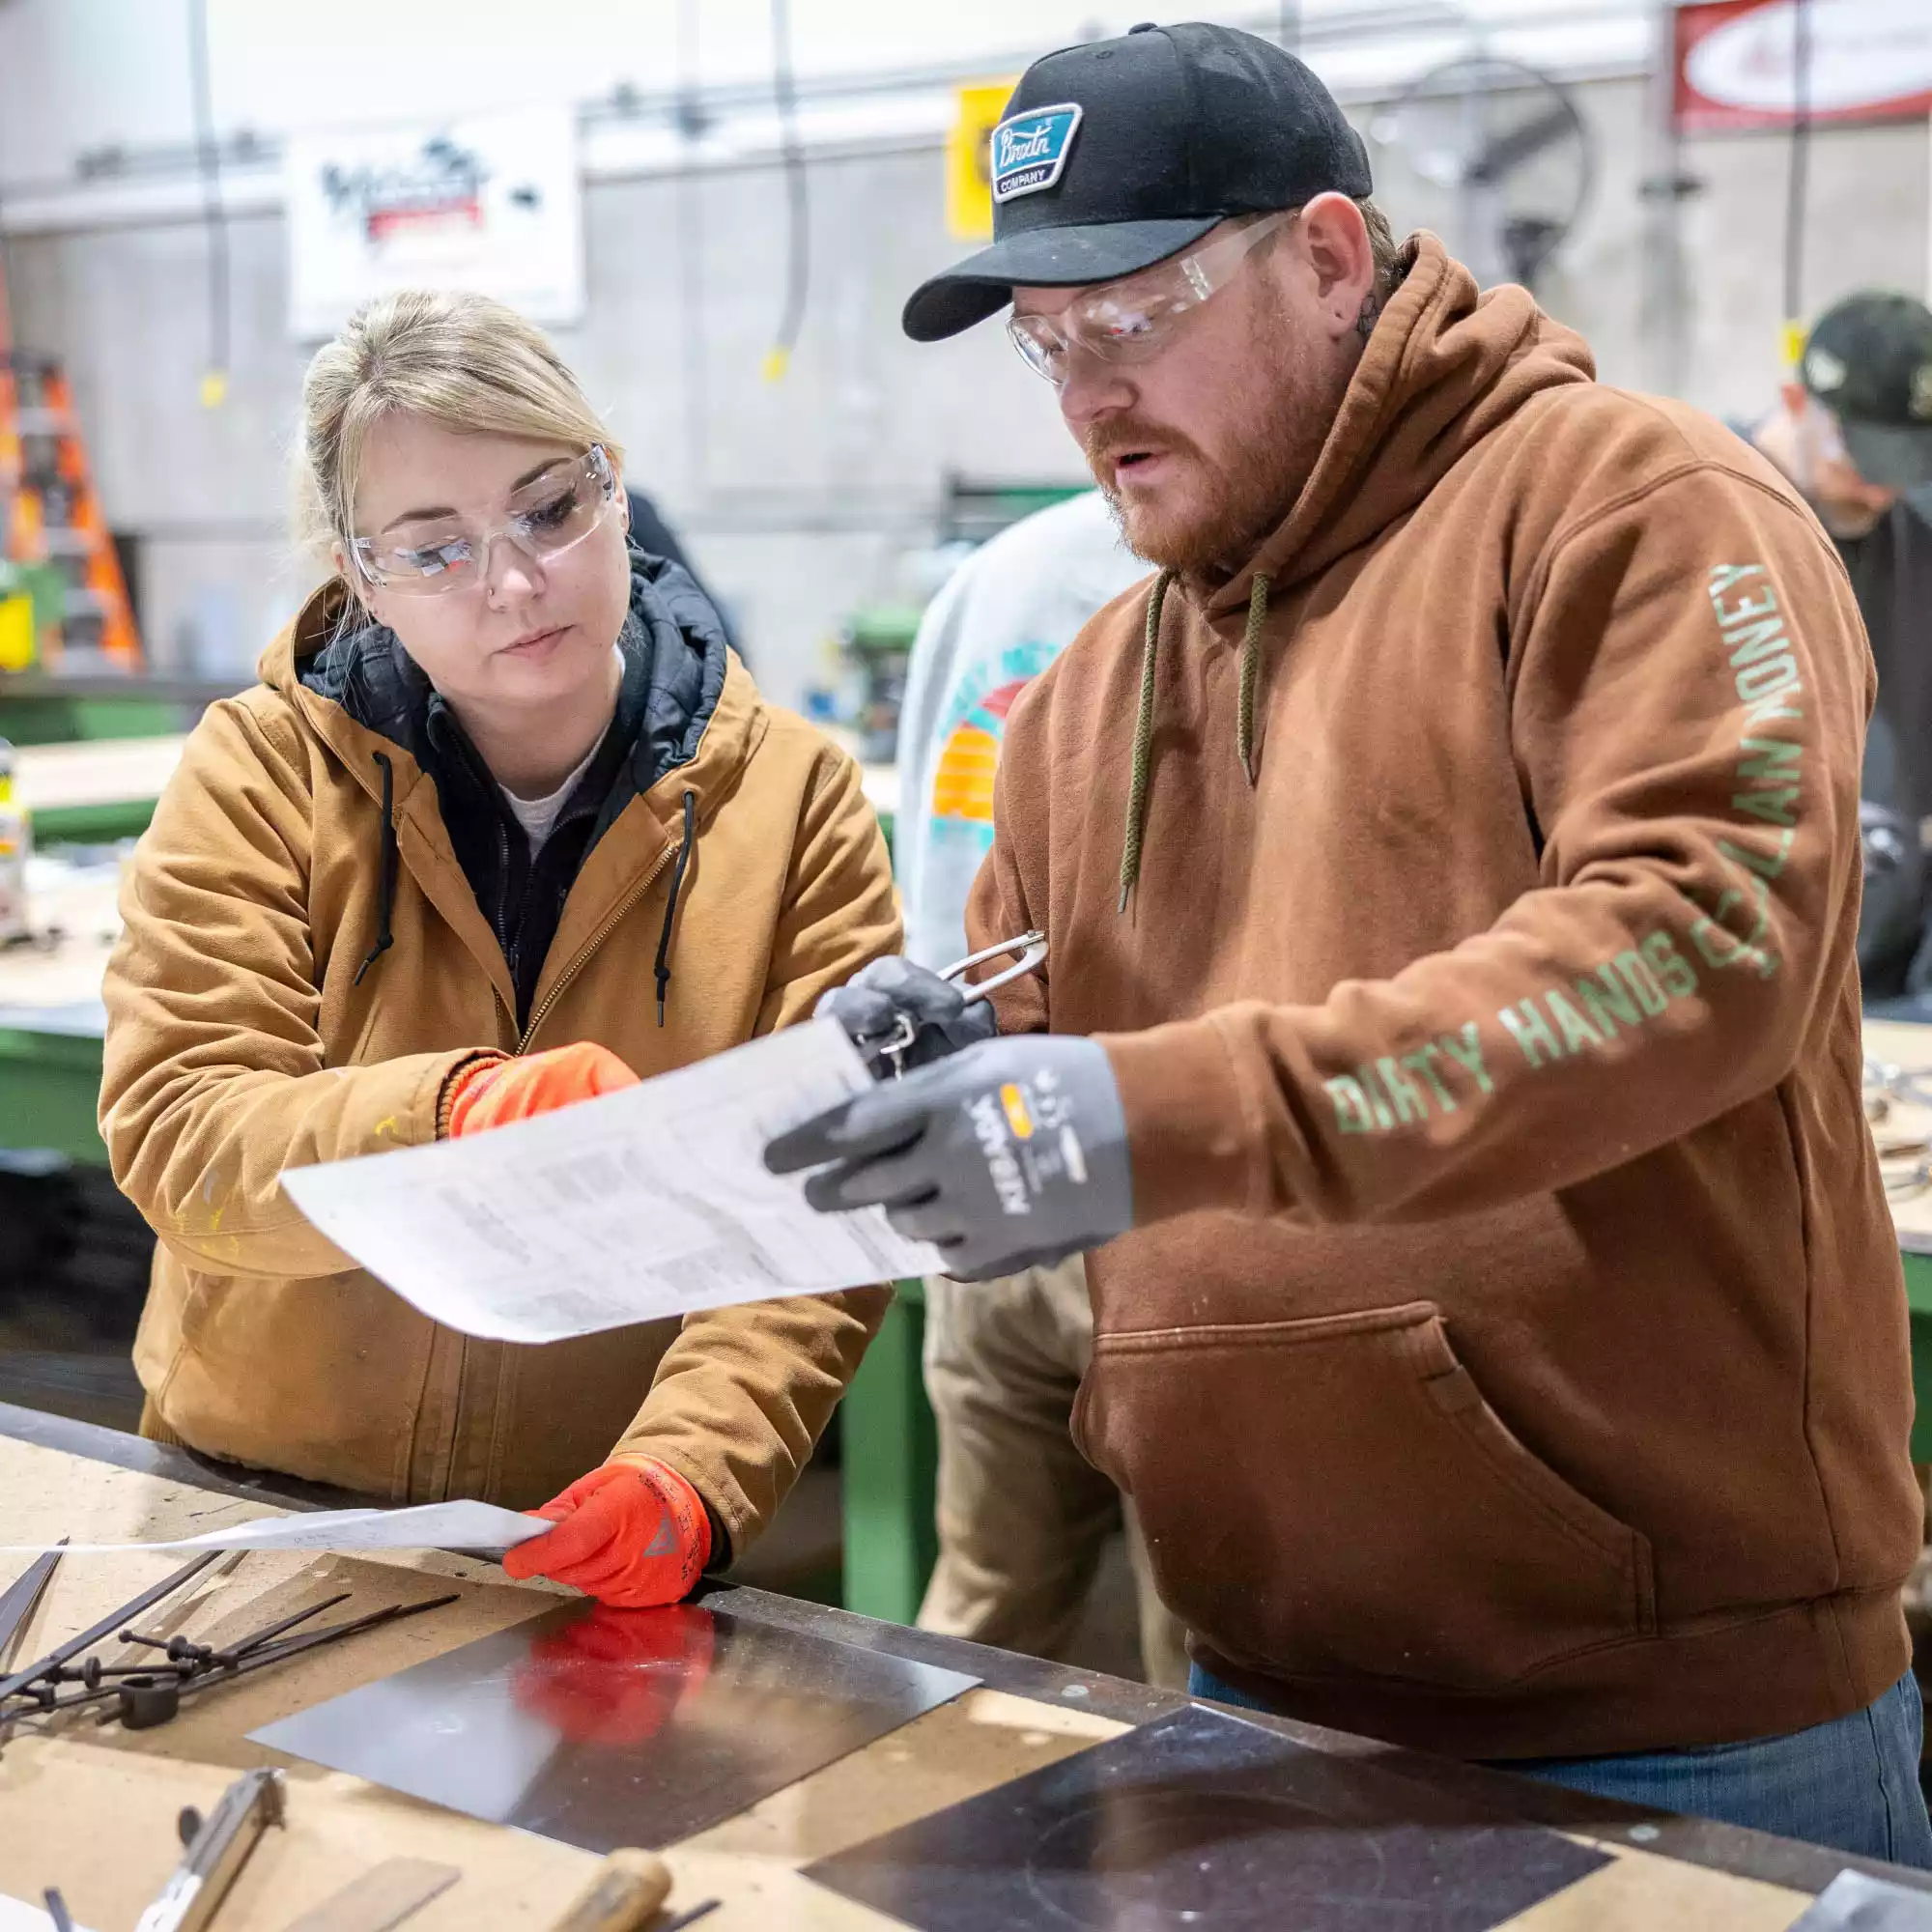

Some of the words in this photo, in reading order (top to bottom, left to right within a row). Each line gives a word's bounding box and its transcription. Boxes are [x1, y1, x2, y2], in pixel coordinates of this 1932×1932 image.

[1000, 169, 1045, 192] COMPANY
[1324, 1020, 1494, 1133] DIRTY
[1497, 930, 1698, 1069] HANDS
[1708, 563, 1804, 730] MONEY
